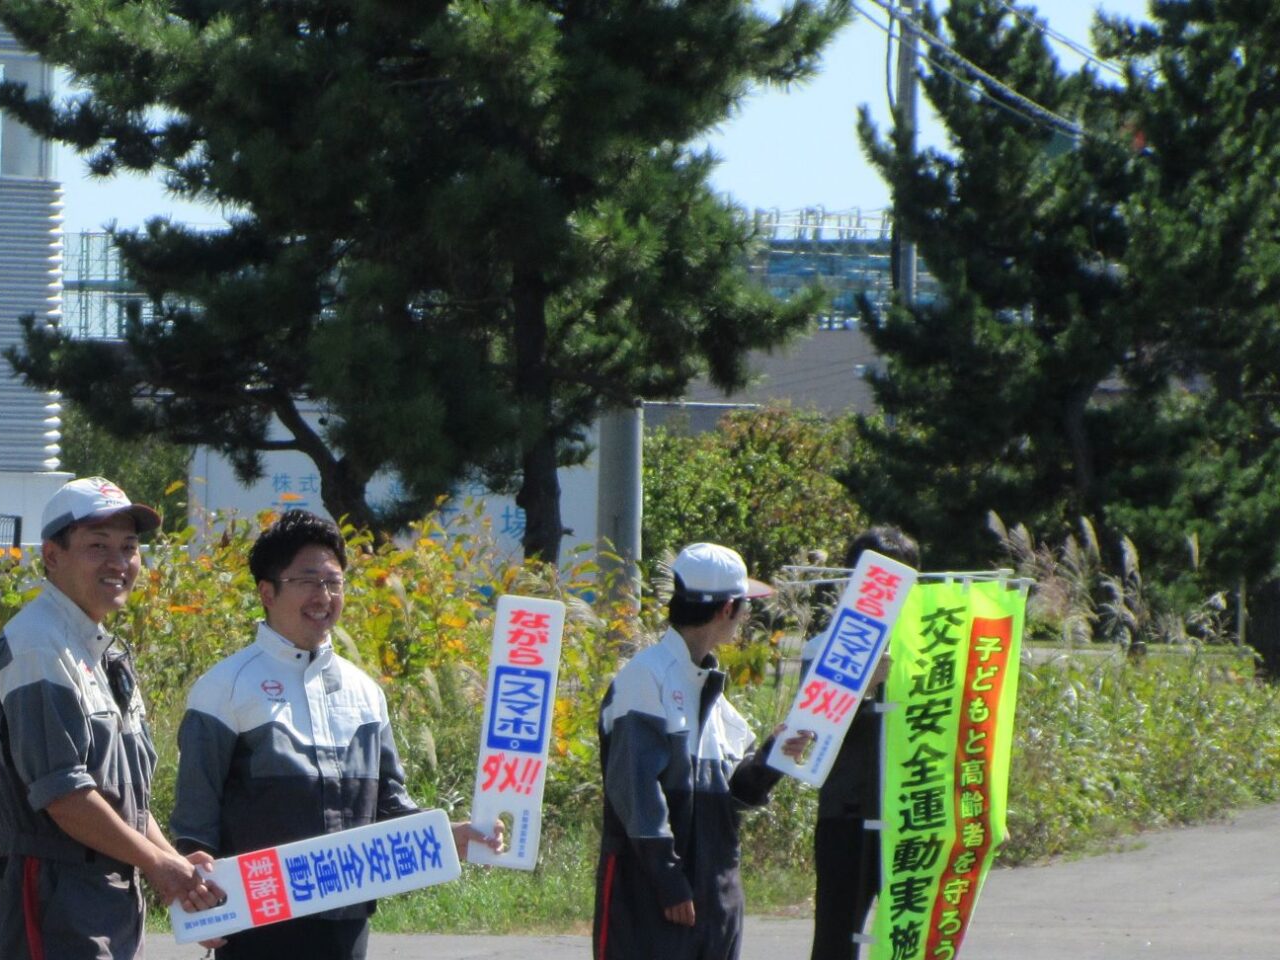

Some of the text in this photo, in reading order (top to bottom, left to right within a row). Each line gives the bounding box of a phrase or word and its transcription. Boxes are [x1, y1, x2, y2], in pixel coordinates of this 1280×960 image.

[855, 564, 903, 618] ながら
[507, 609, 551, 666] ながら
[827, 620, 873, 676] スマホ
[497, 680, 541, 735] スマホ
[481, 751, 542, 796] ダメ!!
[243, 856, 285, 918] 実施中
[284, 825, 443, 902] 交通安全運動
